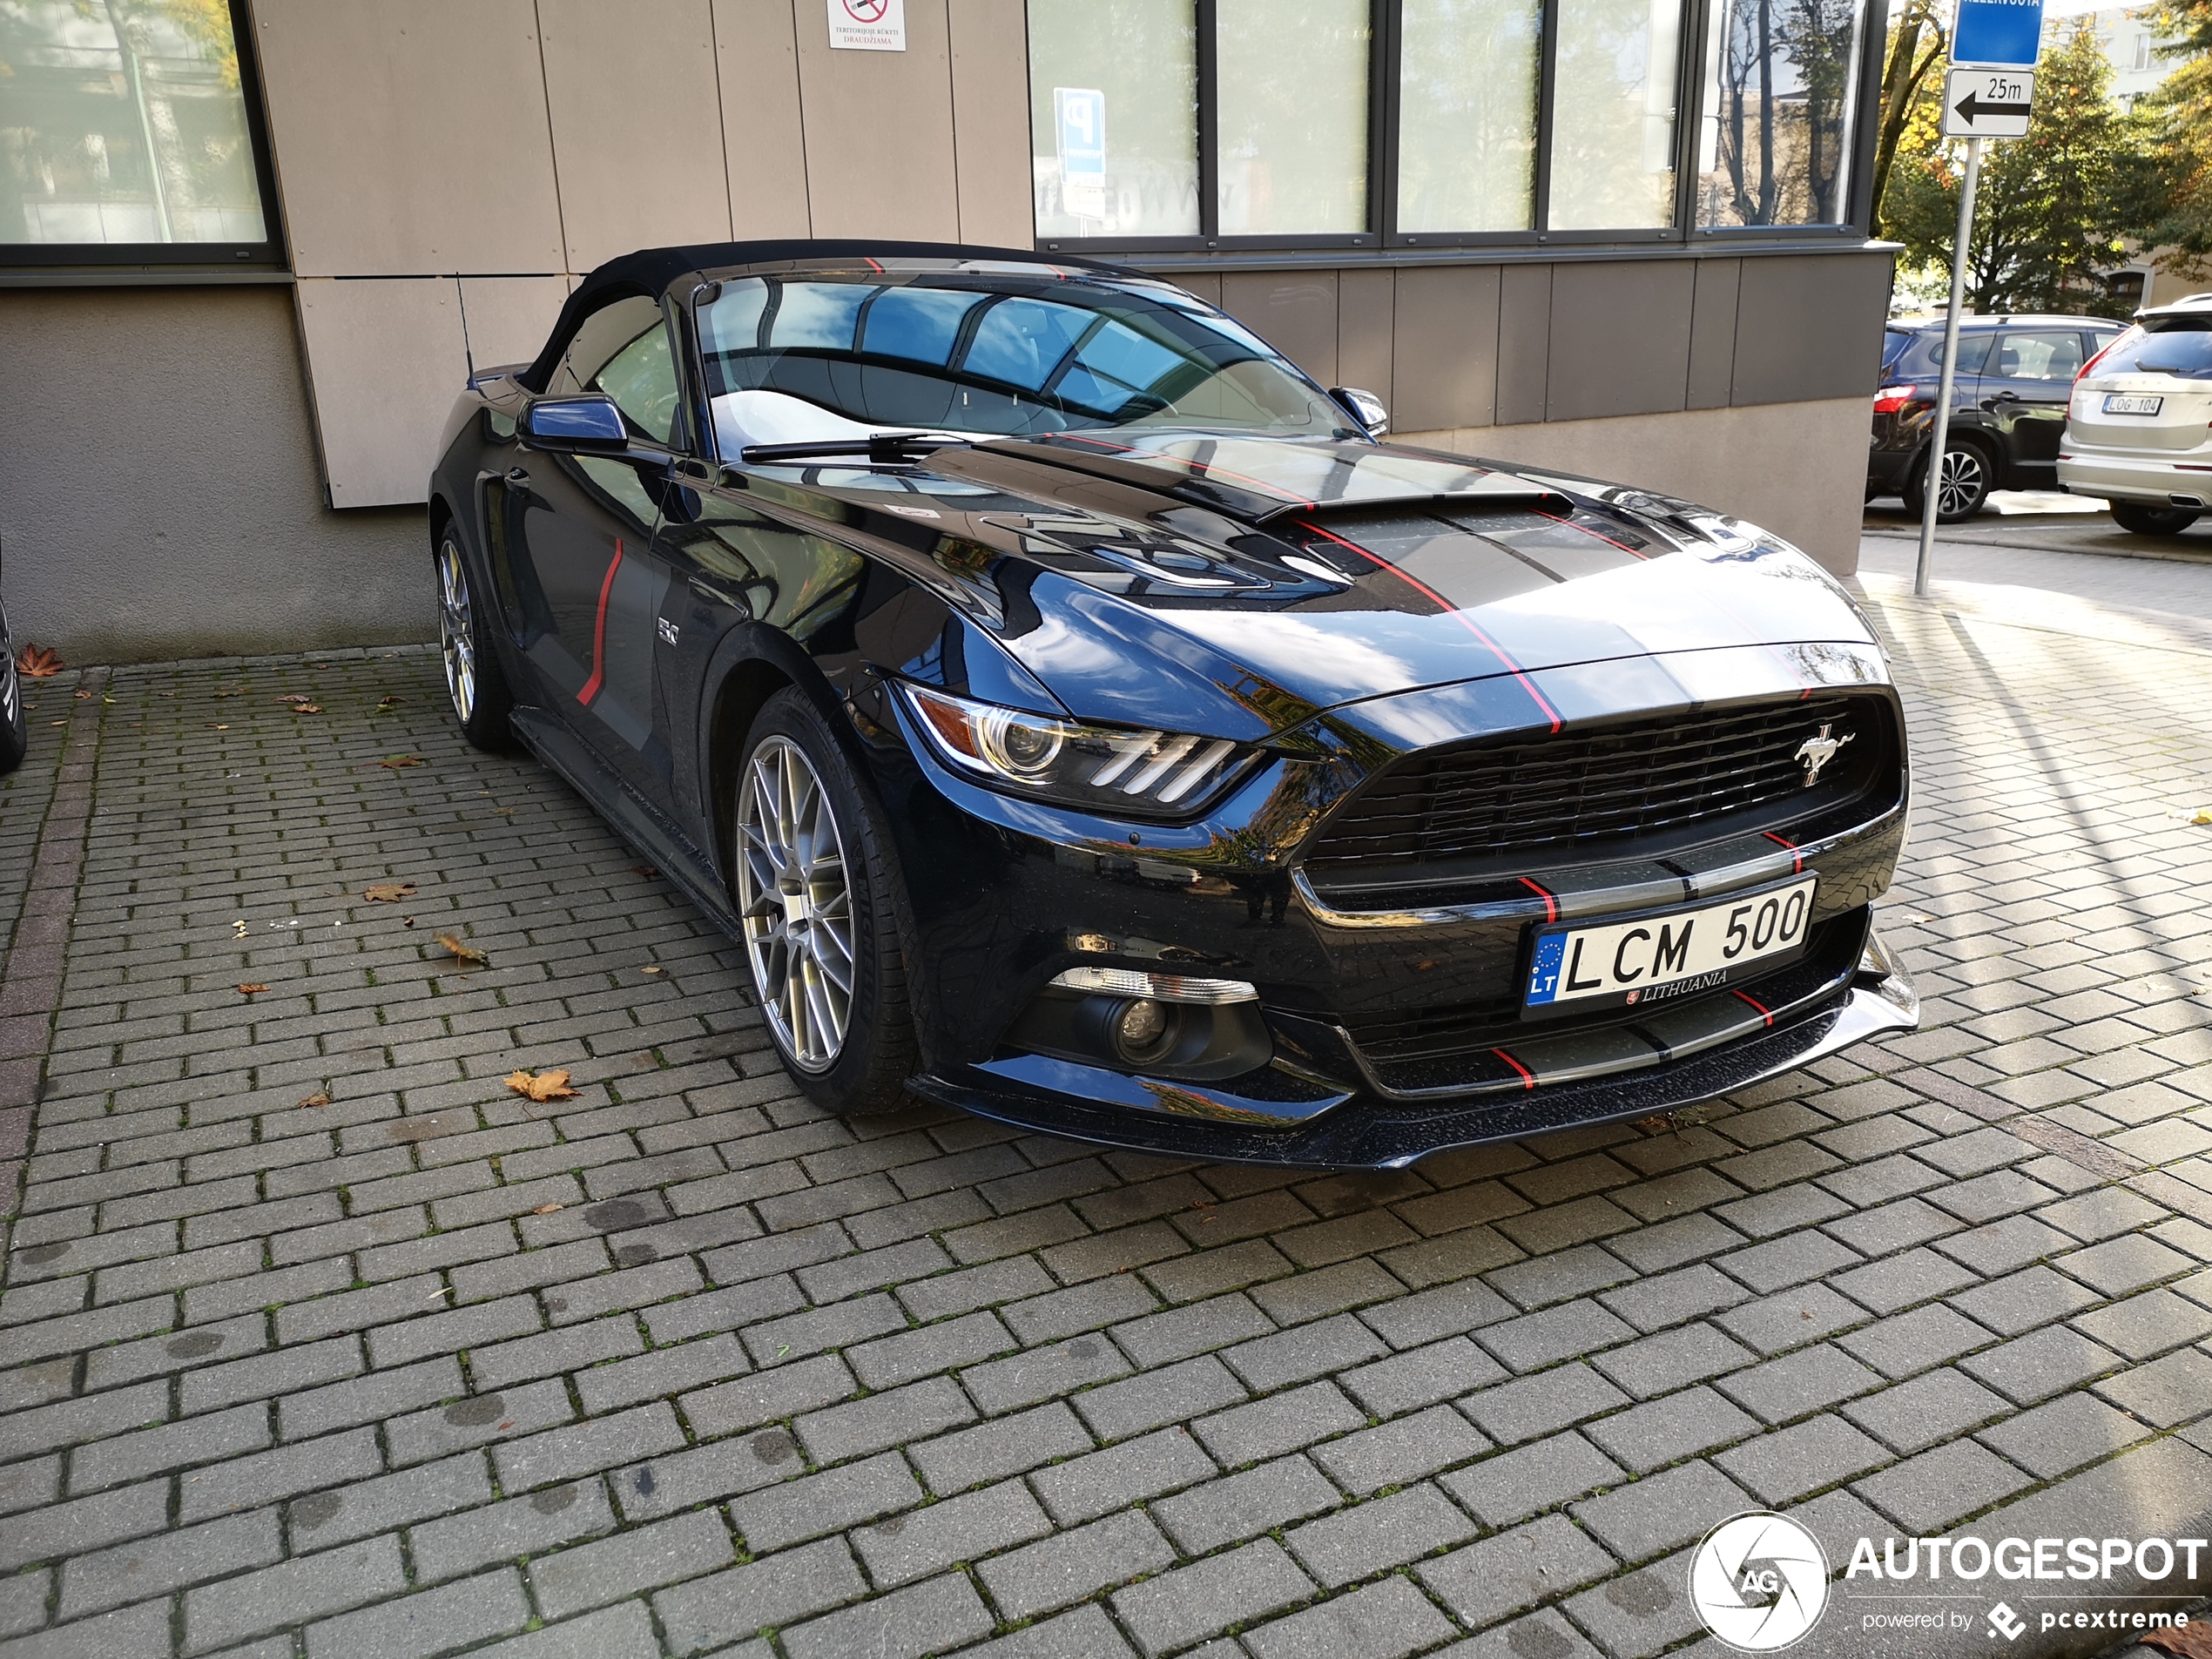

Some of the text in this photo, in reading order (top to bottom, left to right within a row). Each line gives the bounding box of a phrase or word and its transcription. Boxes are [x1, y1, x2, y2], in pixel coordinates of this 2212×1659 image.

[835, 27, 876, 36] TERITORIJOJE
[844, 36, 892, 44] DRAUDŽIAMA
[1987, 78, 2021, 99] 25m
[2109, 398, 2132, 410] LOG
[2139, 399, 2157, 412] 104
[857, 878, 874, 1021] MICHELIN
[1565, 889, 1806, 993] LCM 500
[1530, 974, 1556, 994] LT
[1642, 970, 1727, 1002] LITHUANIA
